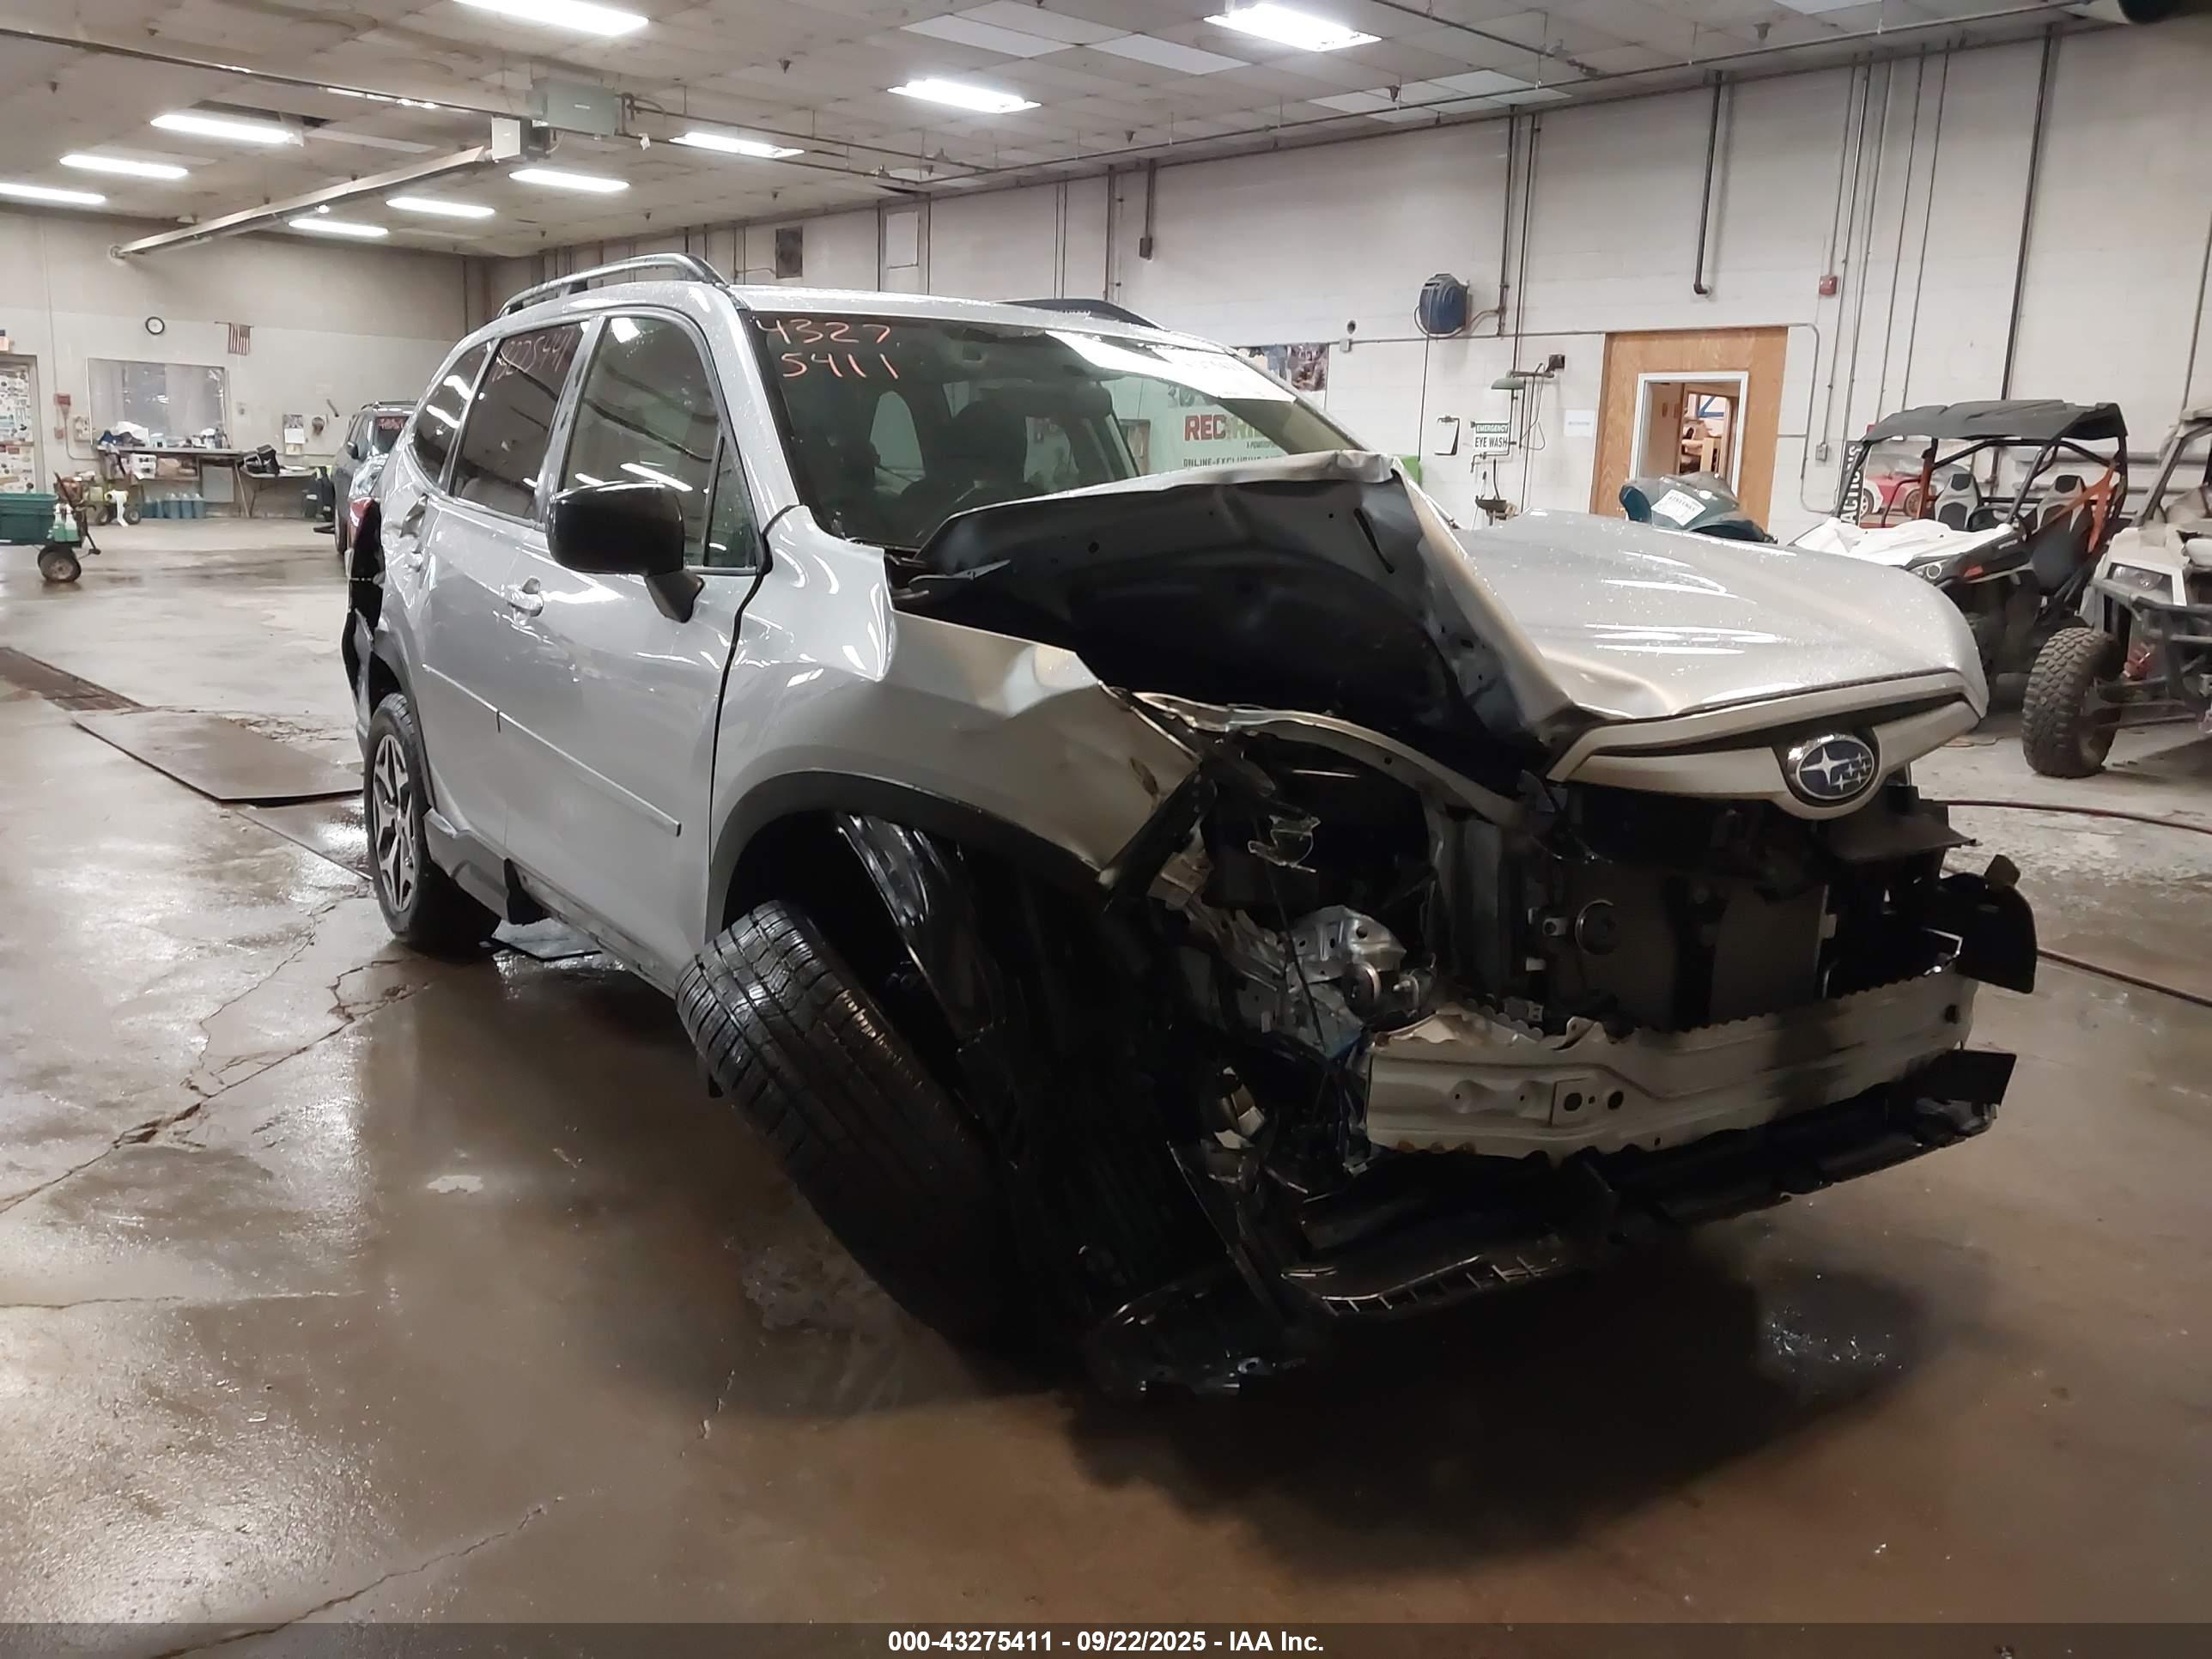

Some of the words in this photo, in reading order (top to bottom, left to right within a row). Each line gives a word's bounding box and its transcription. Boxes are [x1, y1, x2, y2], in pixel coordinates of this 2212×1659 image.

[756, 319, 891, 344] 4327
[781, 352, 899, 380] 5411
[1184, 414, 1227, 441] REC
[1476, 424, 1509, 433] EMERGENCY
[1474, 436, 1487, 447] EYE
[1489, 436, 1508, 447] WASH
